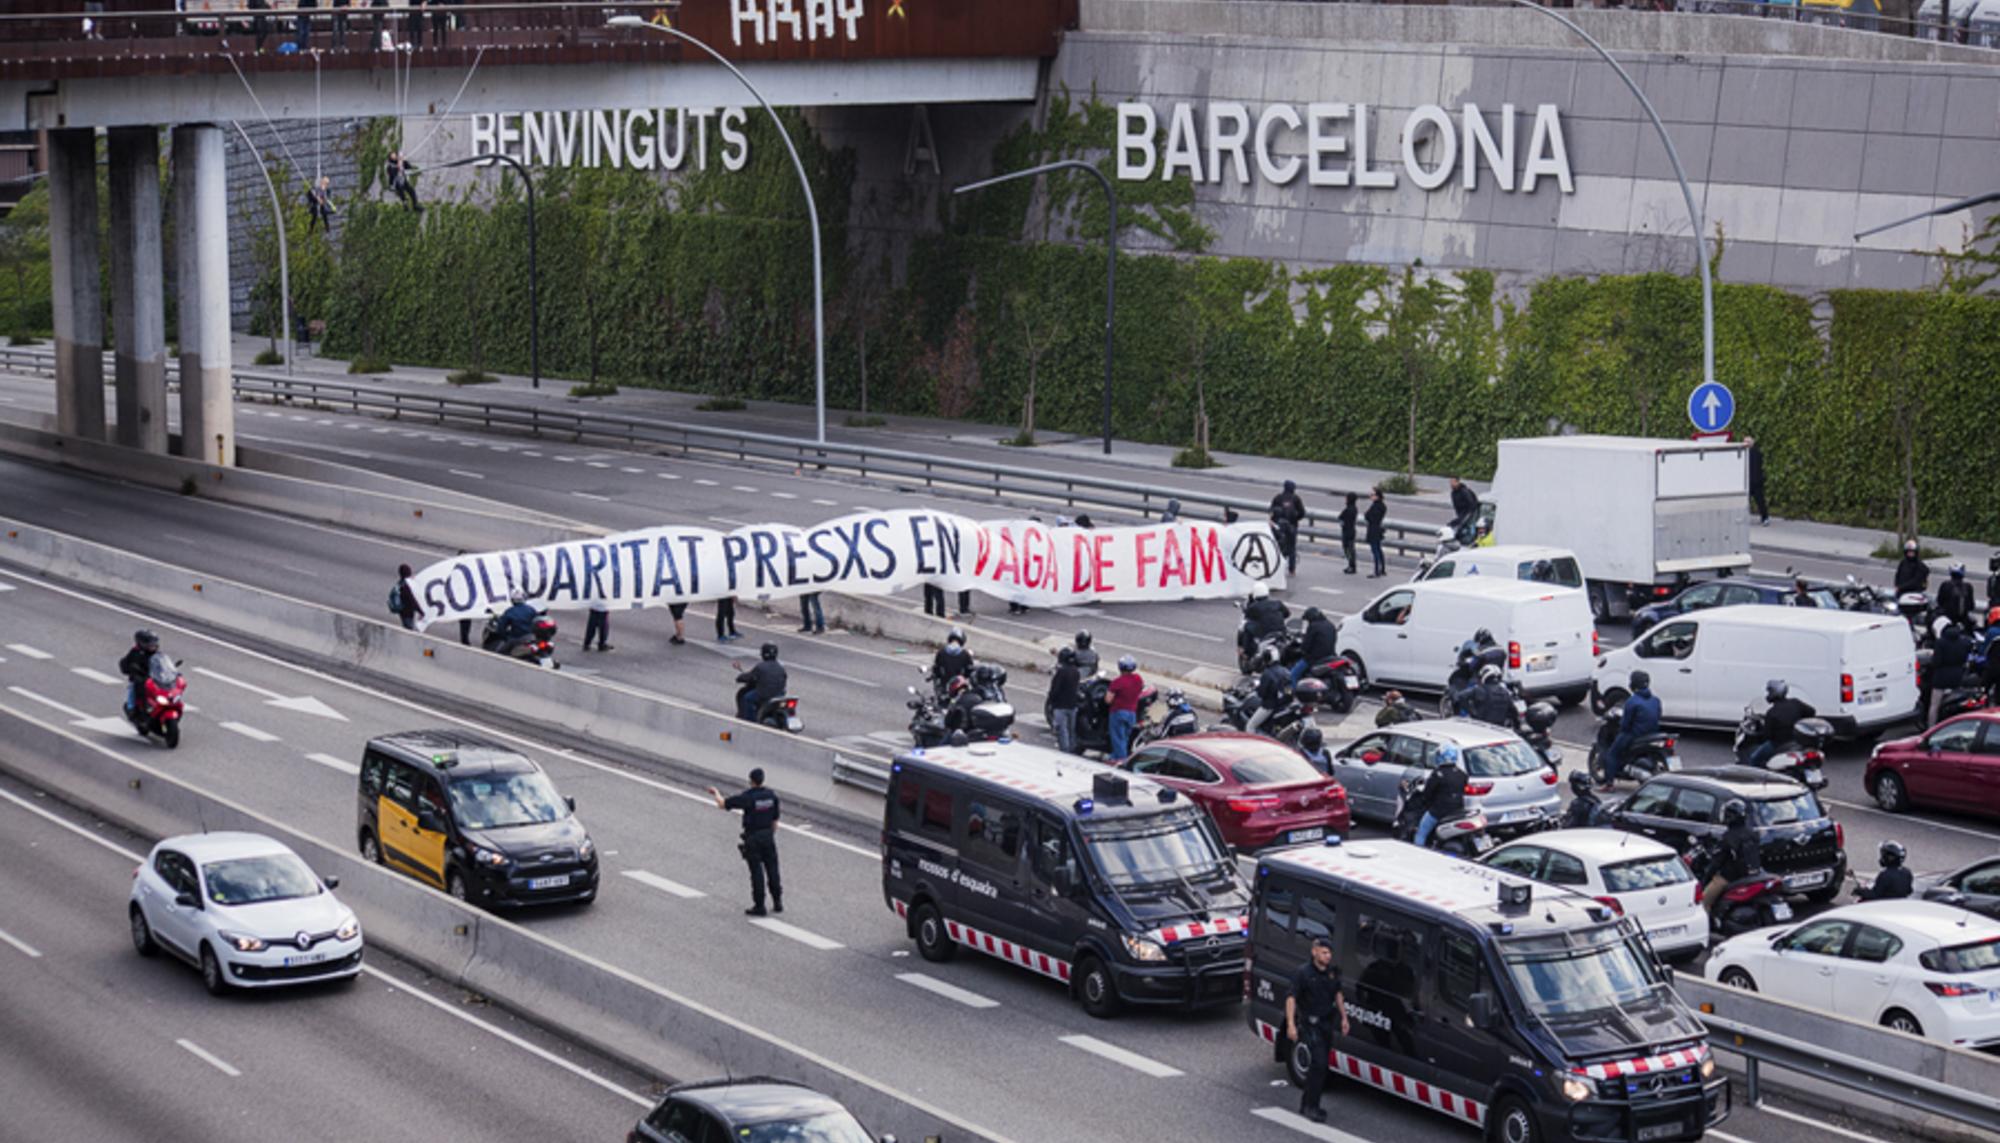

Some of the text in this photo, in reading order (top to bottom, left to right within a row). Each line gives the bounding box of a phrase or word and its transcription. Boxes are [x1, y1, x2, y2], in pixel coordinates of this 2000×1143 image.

[471, 102, 1576, 194] BENVINGUTS A BARCELONA
[424, 535, 704, 616] SOLIDARITAT
[722, 518, 897, 590] PRESXS
[909, 515, 960, 575] EN
[974, 525, 1059, 593] VAGA
[1072, 534, 1116, 594] DE
[1135, 526, 1227, 588] FAM
[917, 858, 949, 879] mossos
[1343, 1002, 1392, 1031] esquadra
